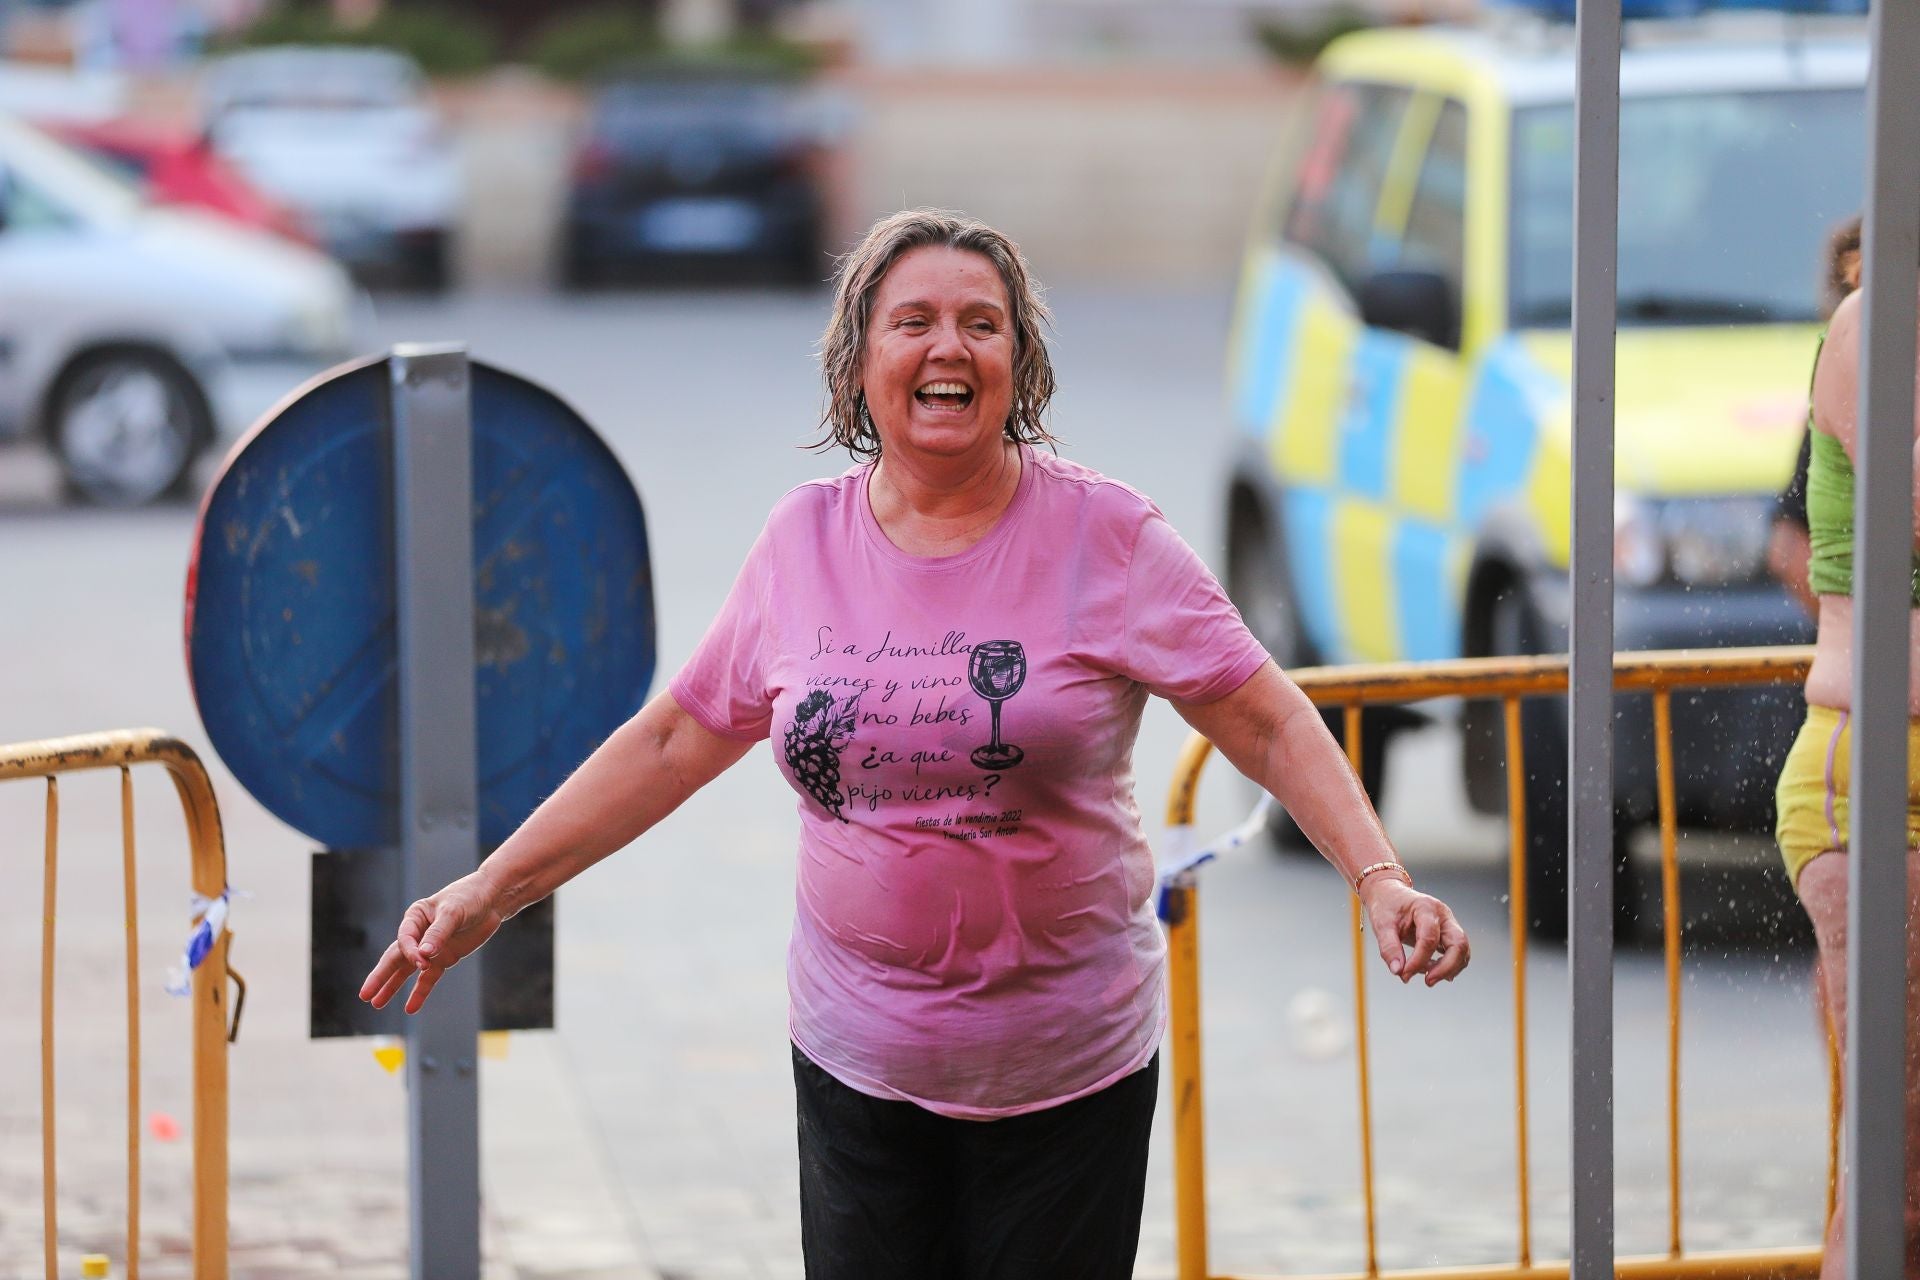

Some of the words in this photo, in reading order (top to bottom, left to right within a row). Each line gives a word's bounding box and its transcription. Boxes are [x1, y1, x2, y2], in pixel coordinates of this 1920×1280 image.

[810, 625, 836, 661] Si
[843, 643, 862, 654] a
[866, 630, 973, 663] Jumilla
[805, 673, 877, 691] vienes
[882, 679, 903, 703] y
[911, 675, 962, 690] vino
[862, 711, 898, 725] no
[910, 695, 974, 726] bebes
[861, 746, 903, 770] ¿a
[910, 750, 955, 776] que
[847, 783, 892, 812] pijo
[902, 774, 1001, 801] vienes?
[915, 816, 941, 828] Fiestas
[943, 813, 952, 826] de
[955, 812, 962, 825] la
[965, 811, 998, 824] vendimia
[999, 809, 1022, 822] 2022
[979, 826, 992, 839] San
